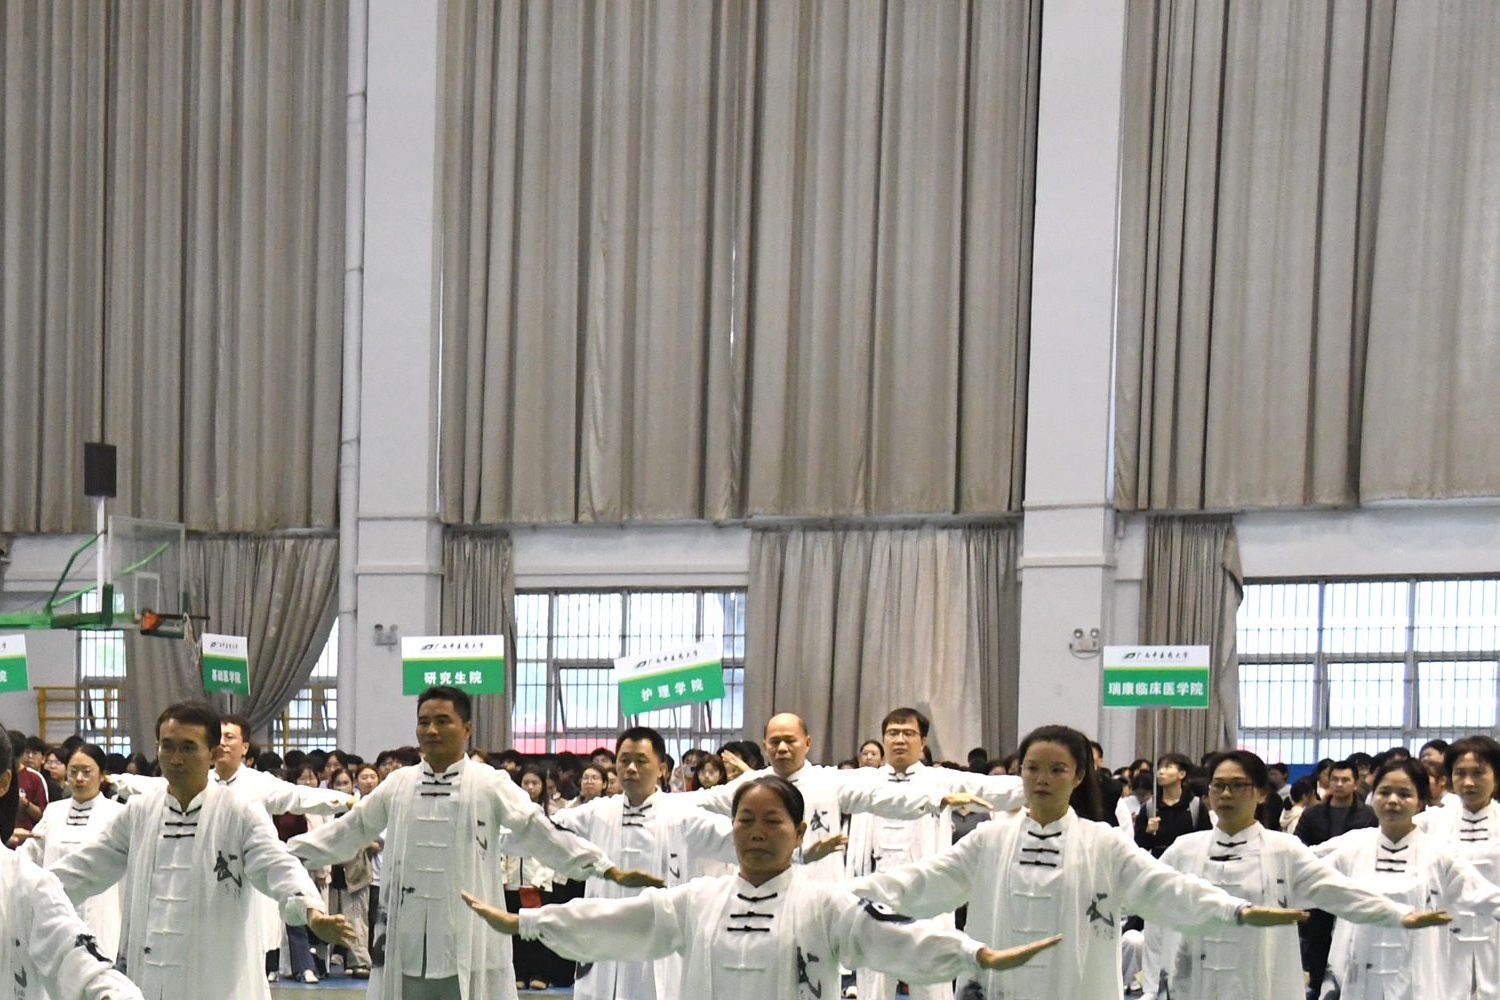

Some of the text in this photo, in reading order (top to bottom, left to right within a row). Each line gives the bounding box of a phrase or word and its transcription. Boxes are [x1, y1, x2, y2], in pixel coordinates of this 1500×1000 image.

[211, 669, 242, 684] 基础医学院
[423, 671, 483, 685] 研究生院
[641, 678, 704, 702] 护理学院
[1108, 681, 1204, 696] 瑞康临床医学院
[214, 851, 242, 888] 武
